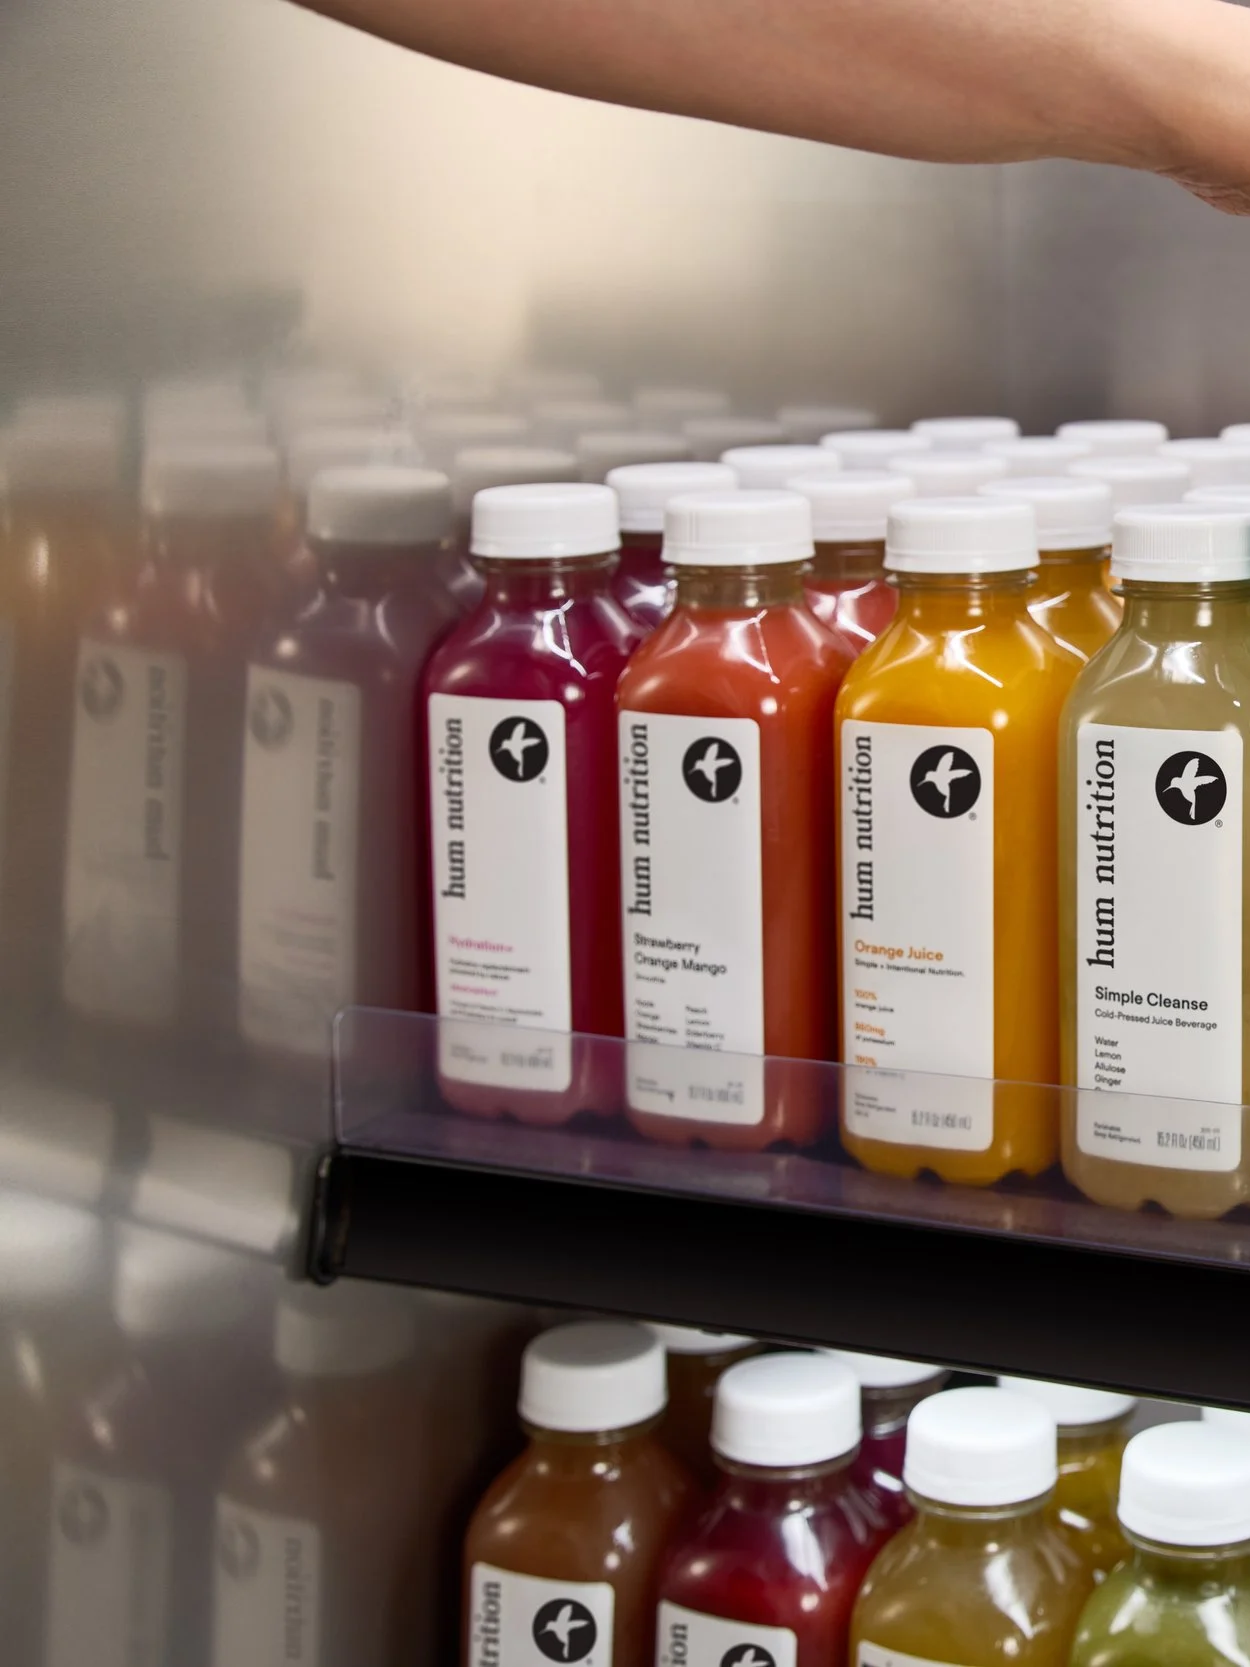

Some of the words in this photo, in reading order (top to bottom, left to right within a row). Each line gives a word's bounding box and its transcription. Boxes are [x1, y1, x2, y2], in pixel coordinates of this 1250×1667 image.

[439, 717, 463, 832] nutrition
[624, 724, 650, 845] nutrition
[848, 736, 873, 851] nutrition
[1086, 739, 1115, 885] nutrition
[443, 840, 466, 899] hum
[628, 855, 652, 917] hum
[850, 861, 873, 922] hum
[634, 933, 701, 954] Strawberry
[855, 940, 903, 961] Orange
[908, 946, 944, 961] Juice
[1086, 896, 1114, 969] hum
[634, 952, 678, 972] Orange
[682, 959, 727, 976] Mango
[1095, 986, 1143, 1006] Simple
[1147, 993, 1208, 1011] Cleanse
[1095, 1008, 1150, 1024] Cold-Pressed
[1152, 1016, 1173, 1026] Juice
[1175, 1018, 1217, 1031] Beverage
[1094, 1036, 1118, 1047] Water
[1094, 1049, 1122, 1061] Lemon
[1094, 1074, 1122, 1086] Ginger
